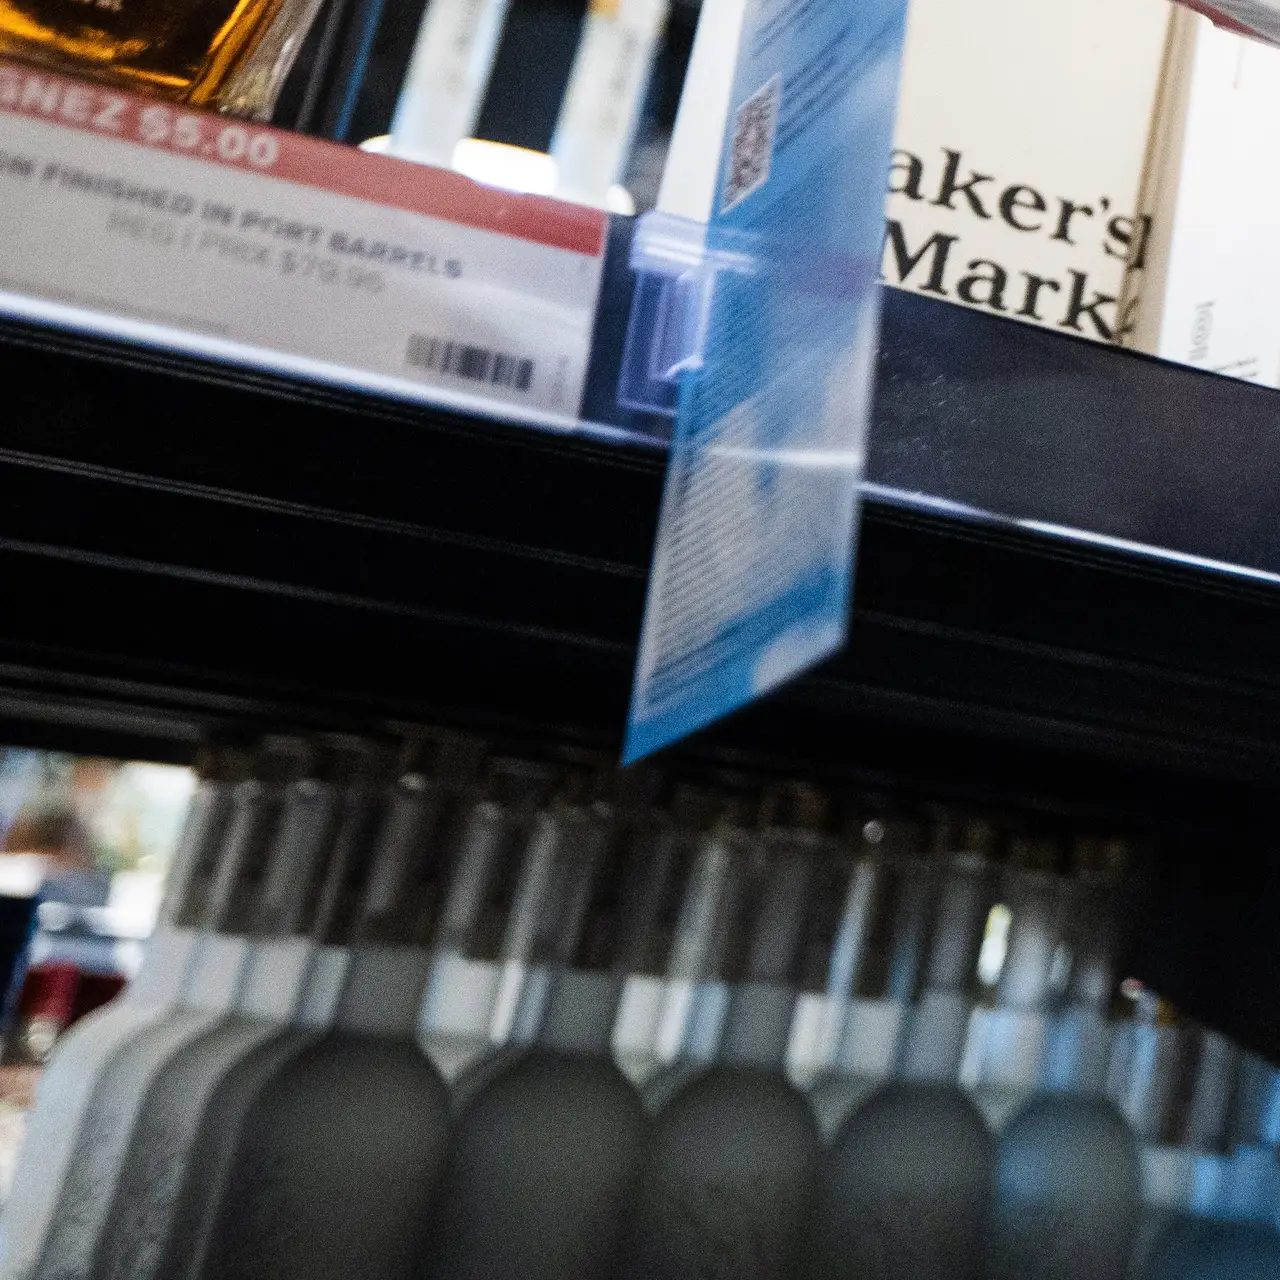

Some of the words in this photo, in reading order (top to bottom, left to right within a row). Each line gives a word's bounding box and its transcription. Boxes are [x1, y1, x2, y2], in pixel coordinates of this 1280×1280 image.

[140, 106, 279, 166] $5.00
[885, 146, 1139, 262] aker's
[880, 218, 1125, 347] Mark
